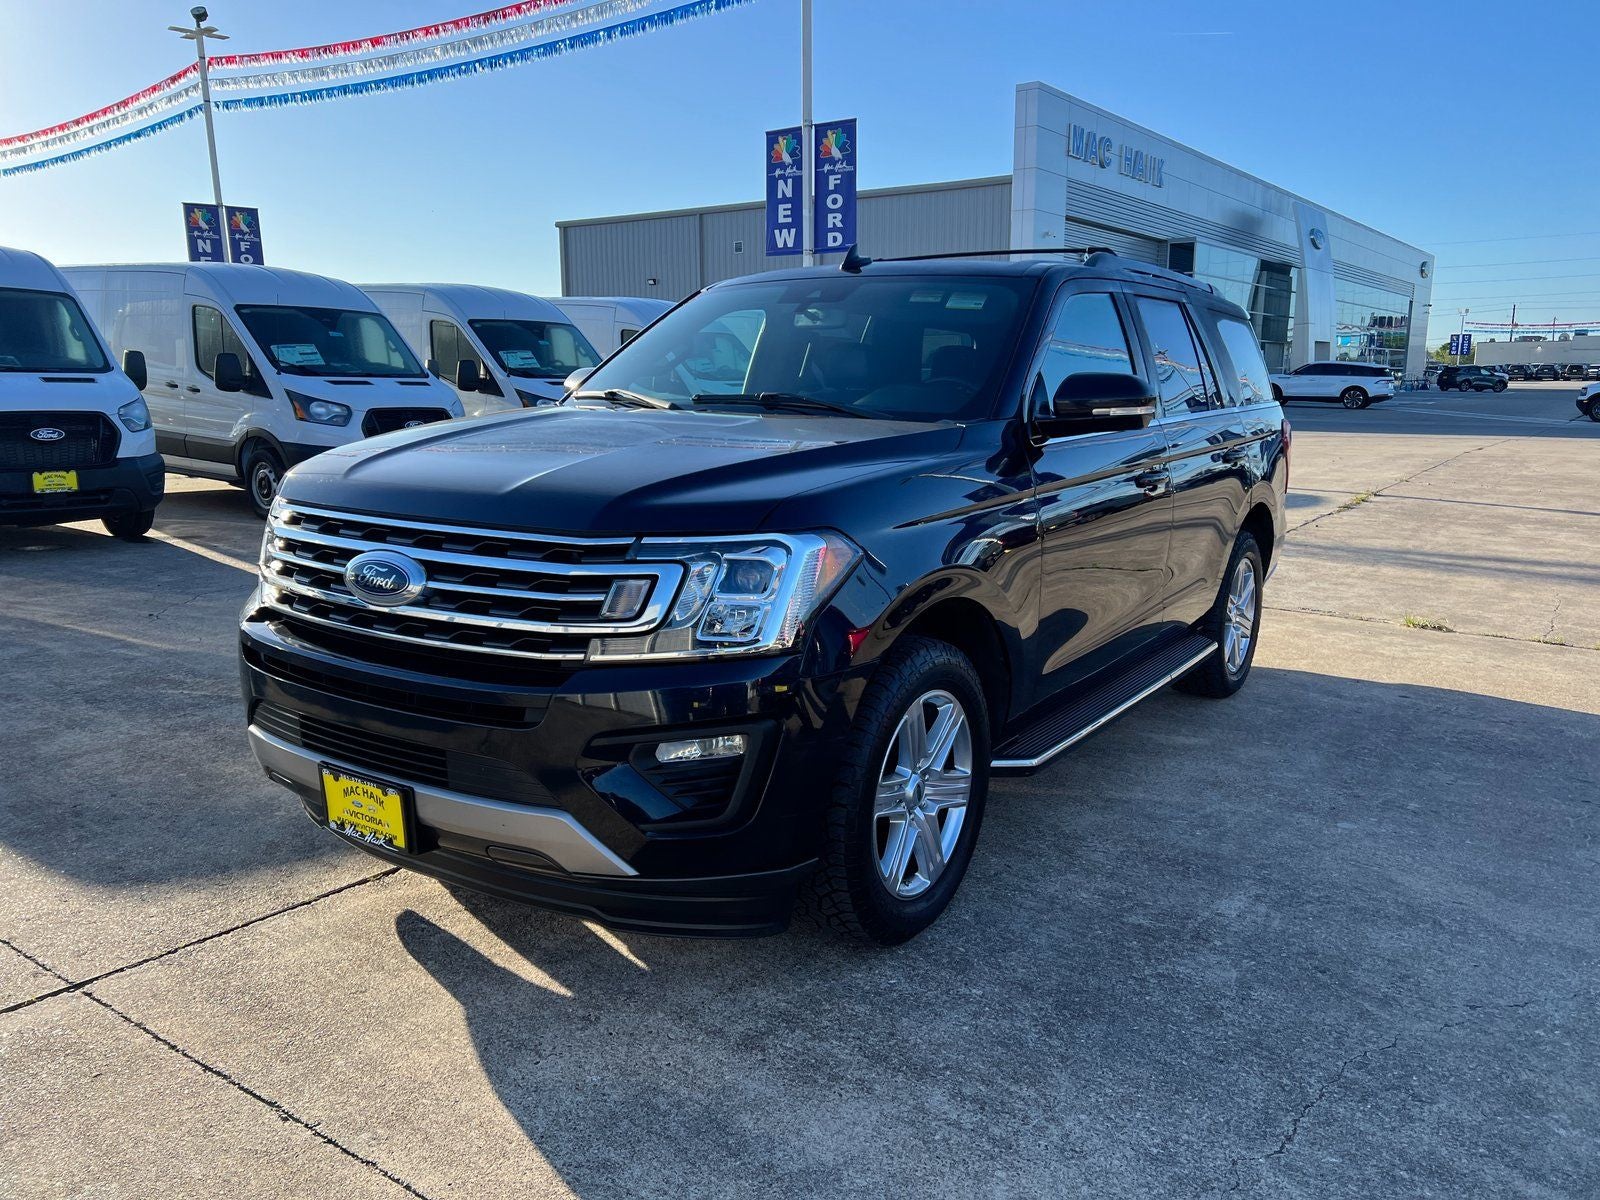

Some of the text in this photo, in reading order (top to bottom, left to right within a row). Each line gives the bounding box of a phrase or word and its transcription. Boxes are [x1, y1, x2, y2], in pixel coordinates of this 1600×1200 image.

[1068, 123, 1165, 188] MAC HAIK
[774, 178, 796, 249] NEW
[826, 174, 844, 248] FORD
[36, 430, 59, 439] Ford
[358, 564, 396, 590] Ford
[343, 785, 361, 798] MAC
[362, 787, 385, 809] HAIK
[349, 809, 384, 827] VICTORIA
[342, 824, 393, 849] Mac Haik
